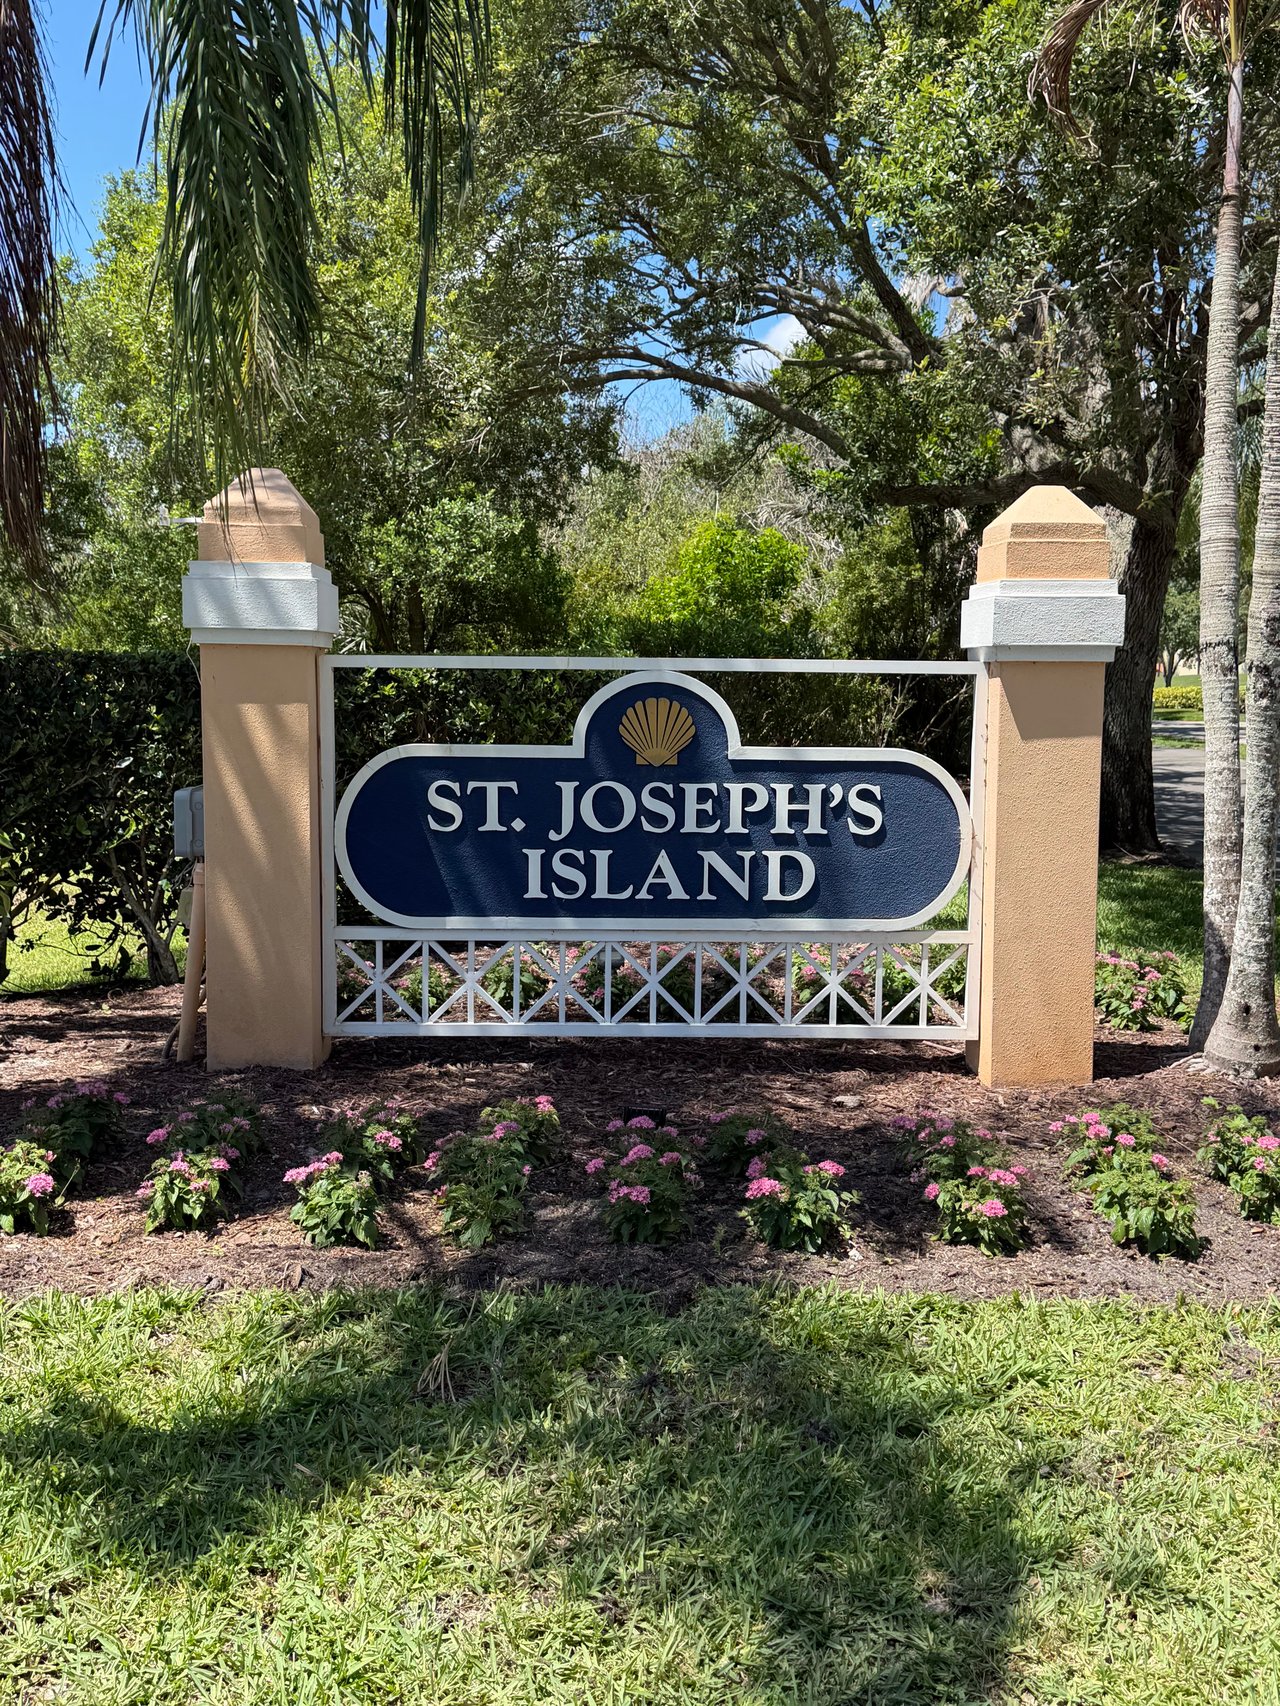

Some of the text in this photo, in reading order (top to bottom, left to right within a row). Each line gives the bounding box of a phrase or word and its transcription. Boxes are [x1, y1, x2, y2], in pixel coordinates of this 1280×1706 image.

[427, 779, 884, 841] ST. JOSEPH'S
[521, 848, 817, 903] ISLAND
